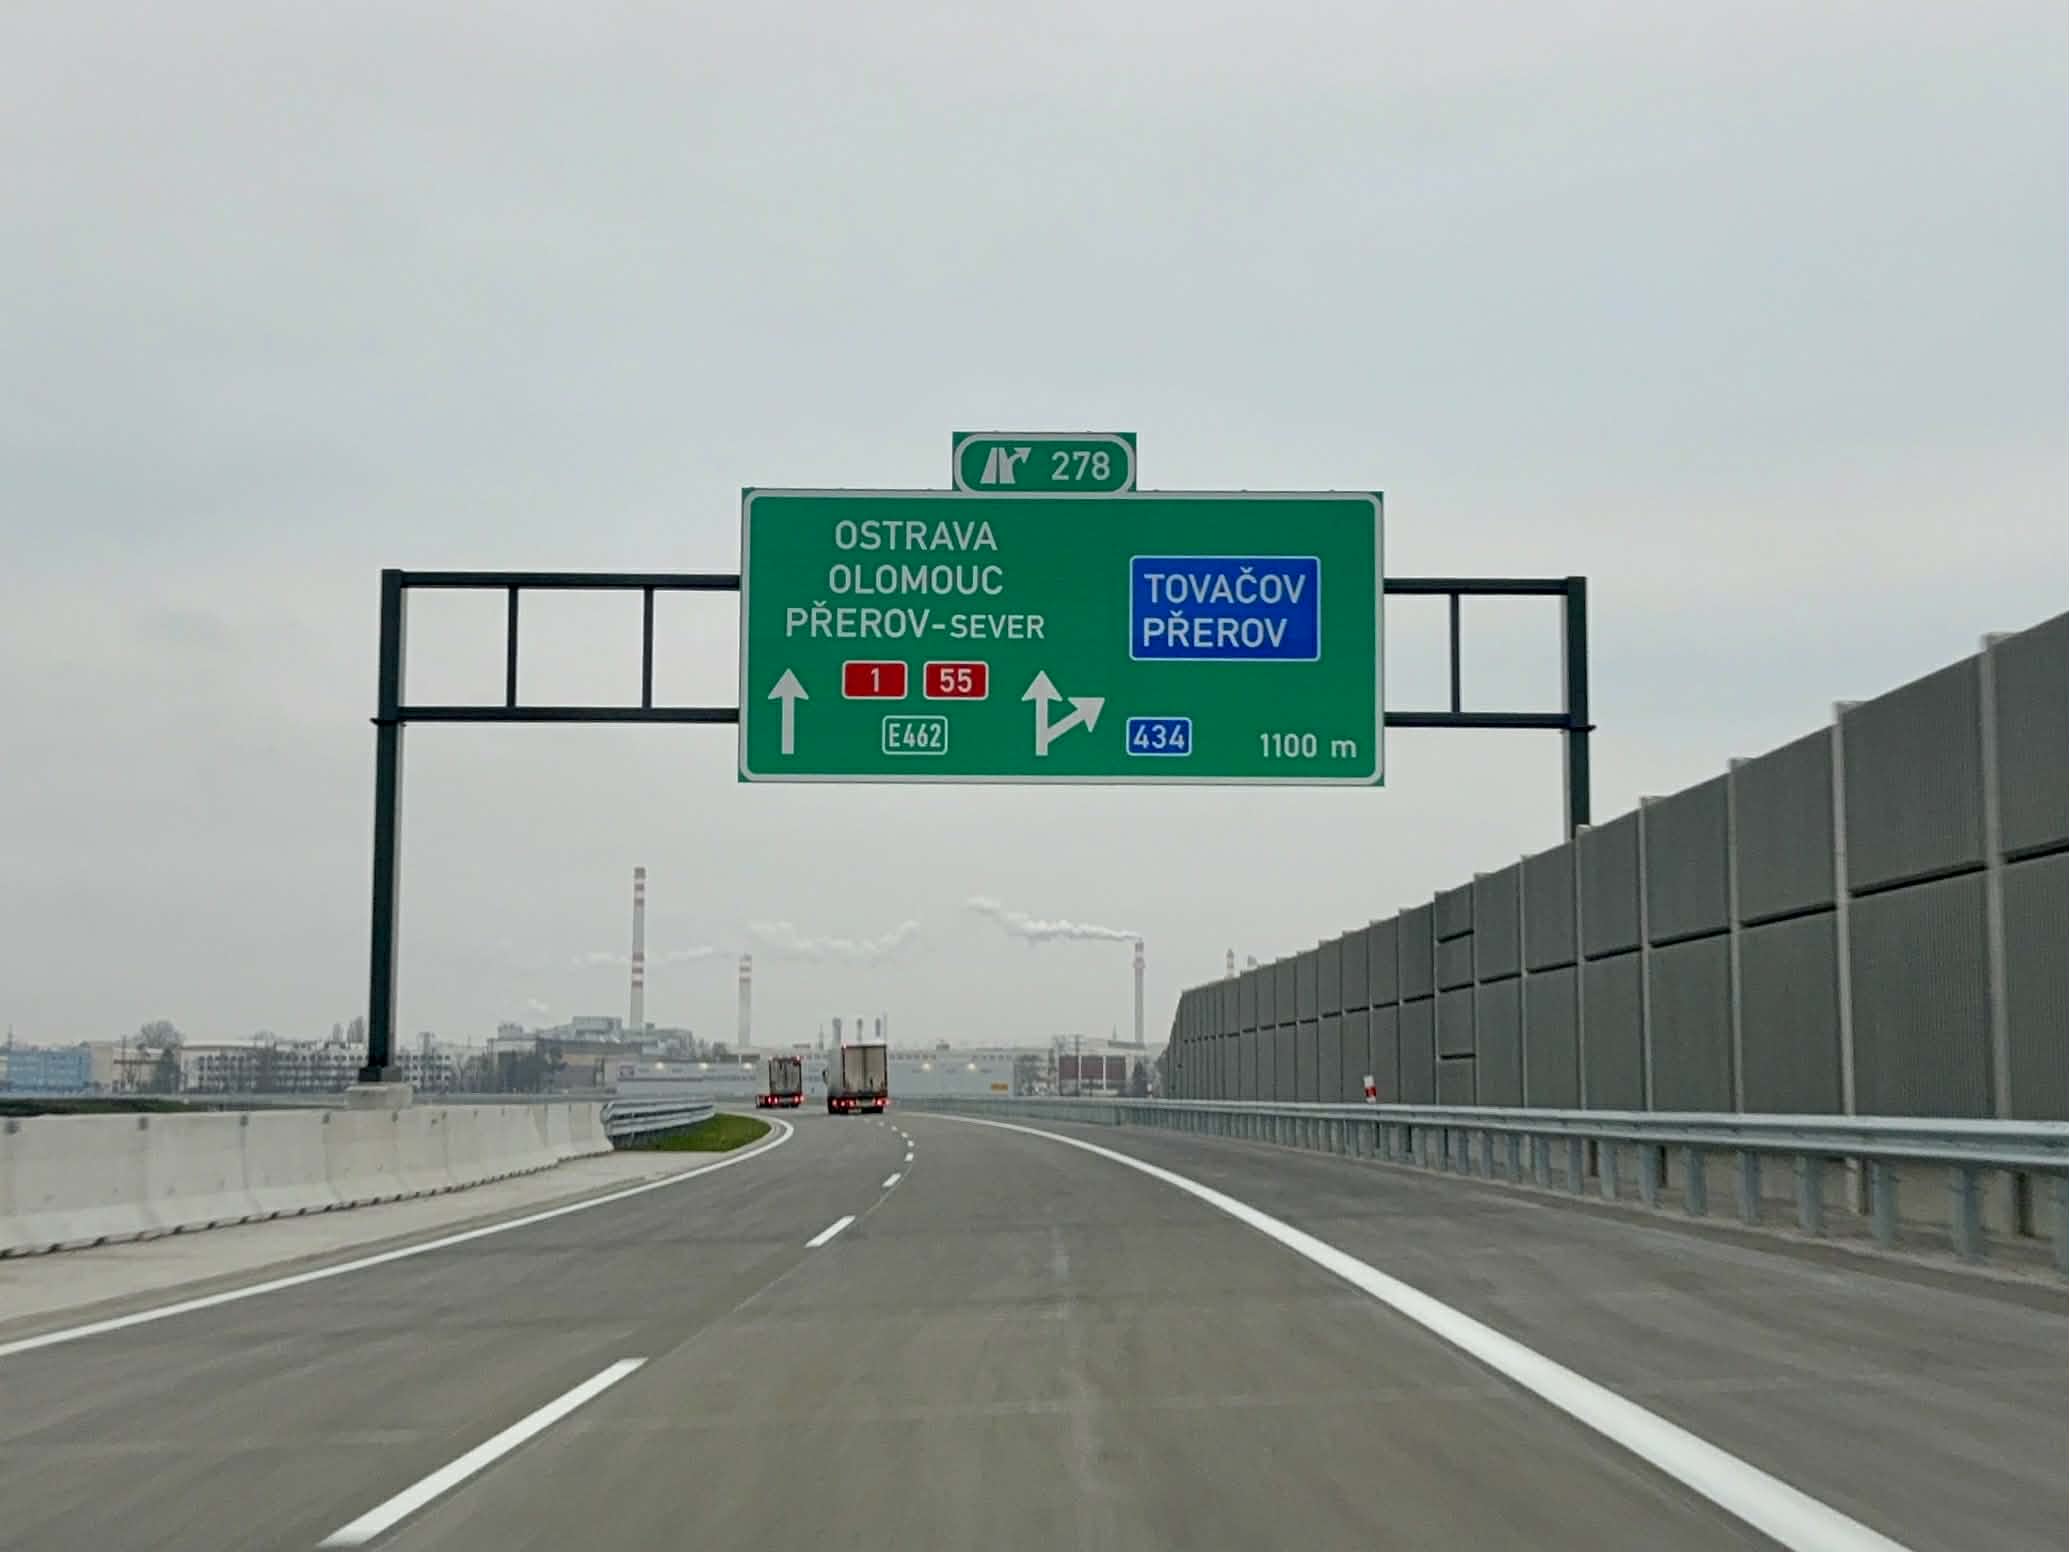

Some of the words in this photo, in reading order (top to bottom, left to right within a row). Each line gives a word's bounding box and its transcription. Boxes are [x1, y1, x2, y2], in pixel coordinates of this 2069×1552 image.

[1051, 451, 1111, 482] 278
[834, 520, 998, 551] OSTRAVA
[829, 564, 1003, 595] OLOMOUC
[1142, 567, 1306, 605] TOVAČOV
[786, 600, 1045, 639] PŘEROV-SEVER
[1142, 610, 1288, 648] PŘEROV
[870, 667, 881, 694] 1
[939, 667, 973, 694] 55
[889, 723, 942, 749] E462
[1132, 724, 1186, 750] 434
[1260, 733, 1318, 759] 1100
[1331, 740, 1358, 759] m
